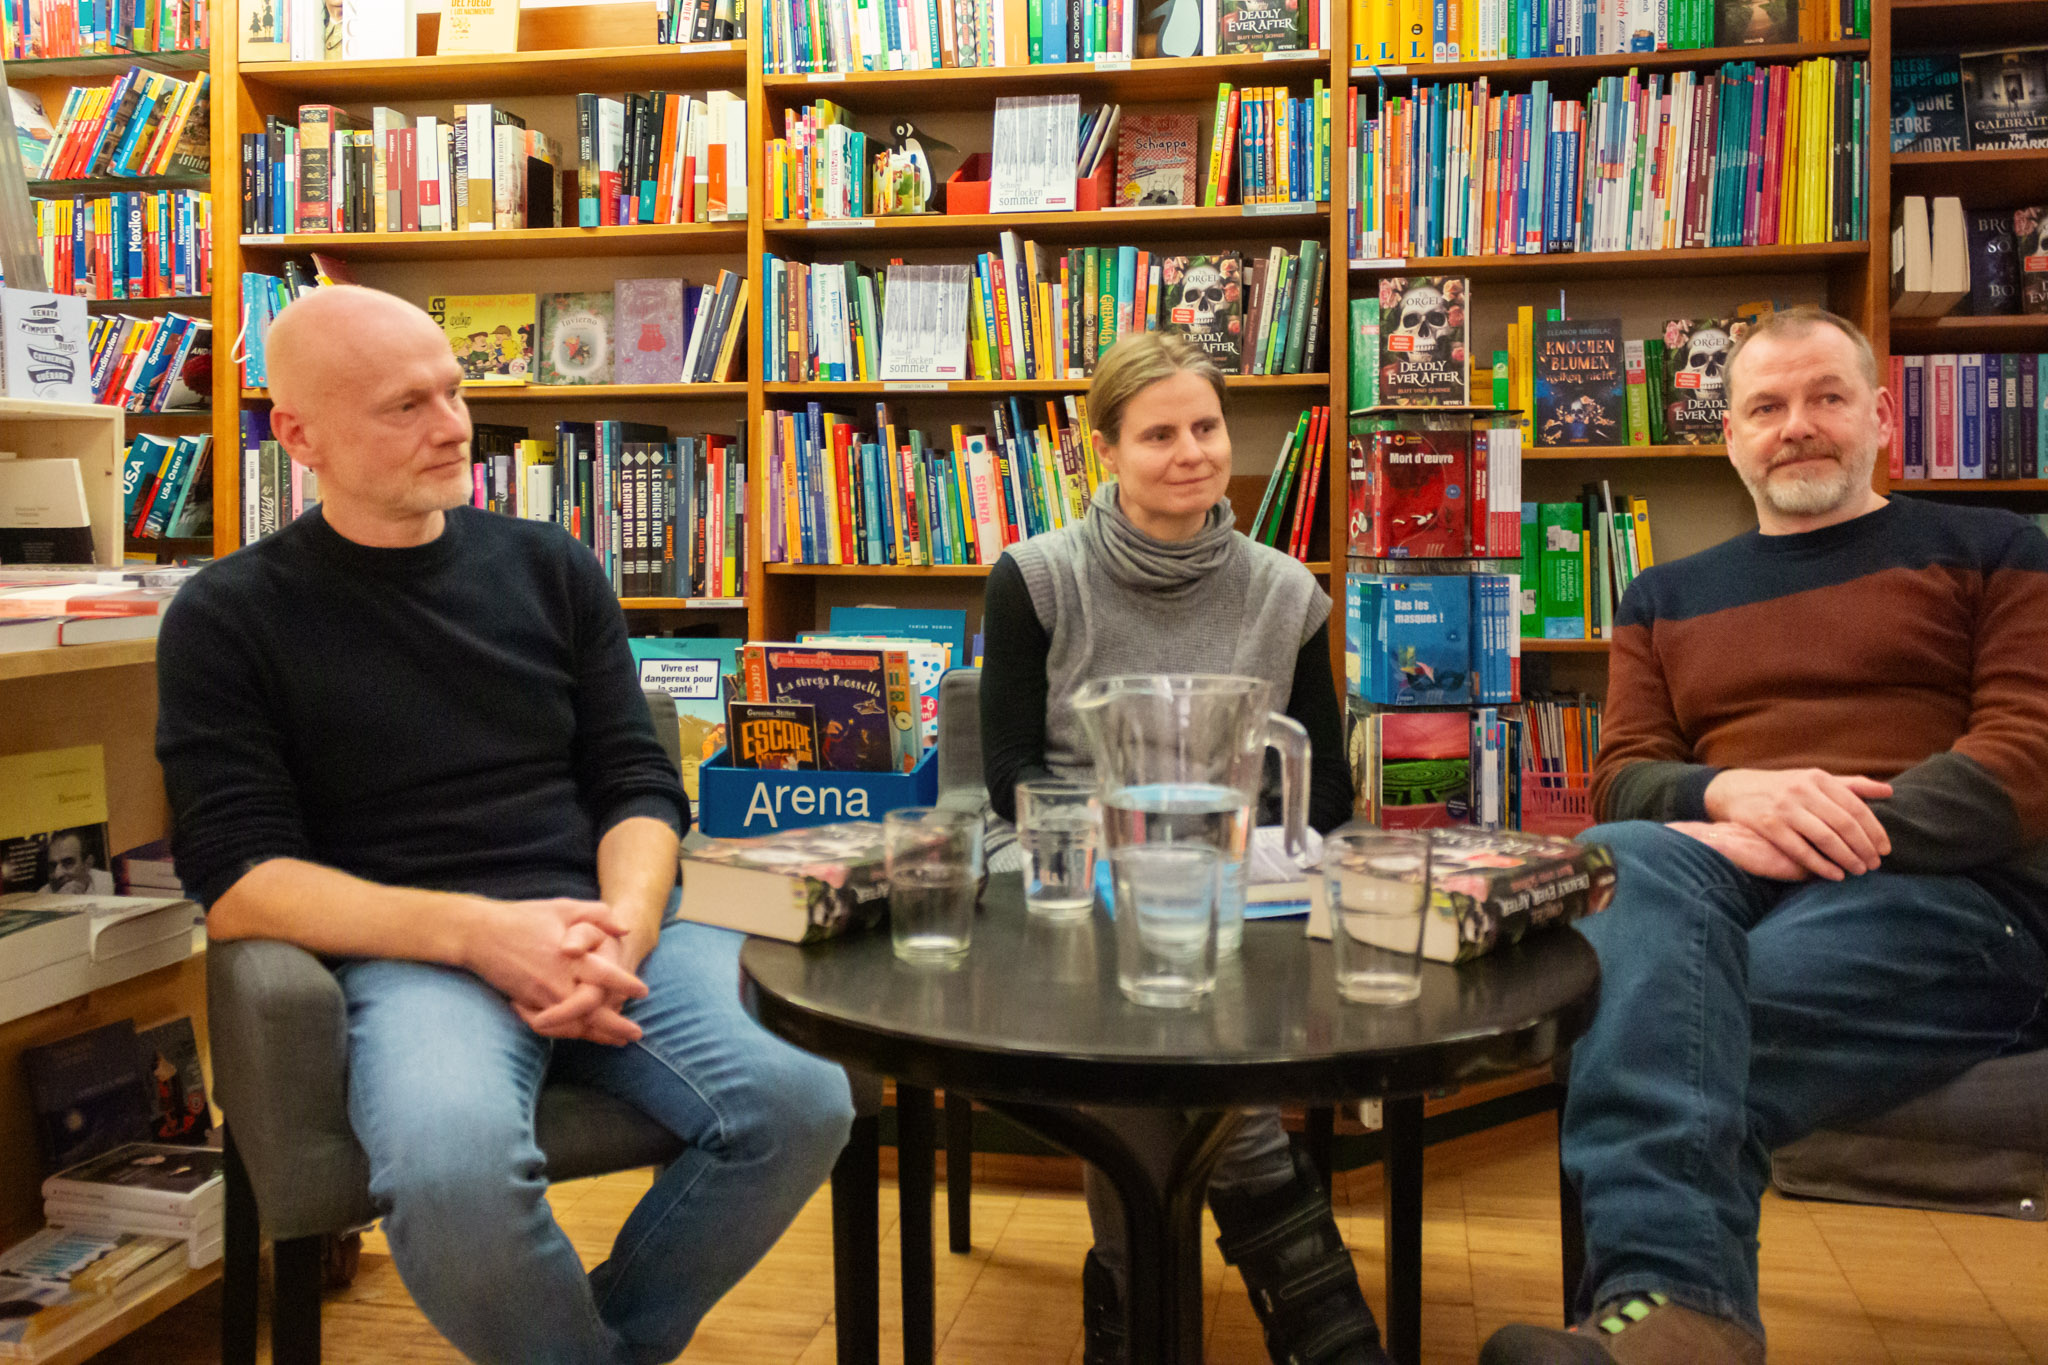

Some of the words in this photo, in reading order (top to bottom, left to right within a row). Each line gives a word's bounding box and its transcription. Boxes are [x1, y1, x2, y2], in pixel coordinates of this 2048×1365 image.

[1238, 8, 1282, 21] DEADLY
[1436, 4, 1444, 31] French
[1449, 4, 1458, 31] French
[1228, 20, 1264, 33] EVER
[1258, 18, 1298, 32] AFTER
[1135, 135, 1187, 154] Schiappa
[1554, 163, 1562, 172] DU
[1567, 163, 1575, 172] DU
[998, 196, 1039, 206] sommer
[75, 213, 83, 242] Marokko
[1552, 203, 1560, 238] GRAMMAIRE
[128, 210, 142, 253] Mexiko
[1187, 274, 1217, 284] ORGEL
[1406, 297, 1440, 308] ORGEL
[32, 309, 59, 318] RENATA
[561, 316, 599, 328] Invierno
[1183, 332, 1224, 343] DEADLY
[1693, 338, 1726, 348] ORGEL
[148, 330, 168, 366] Spanien
[1202, 341, 1241, 355] AFTER
[1546, 339, 1615, 356] KNOCHEN
[90, 332, 120, 389] Skandinavien
[1399, 360, 1447, 373] DEADLY
[1551, 355, 1609, 371] BLUMEN
[889, 364, 929, 373] sommer
[1387, 373, 1428, 387] EVER
[1420, 371, 1465, 386] AFTER
[1675, 409, 1713, 423] EVER
[1389, 453, 1413, 464] Mort
[1414, 453, 1454, 464] d'œuvre
[159, 483, 172, 500] USA
[167, 455, 183, 481] Osten
[622, 470, 633, 481] LE
[636, 469, 648, 480] LE
[651, 469, 662, 479] LE
[622, 482, 633, 519] DERNIER
[636, 482, 648, 519] DERNIER
[651, 481, 662, 519] DERNIER
[974, 474, 991, 525] SCIENZA
[622, 522, 633, 548] ATLAS
[636, 521, 648, 548] ATLAS
[651, 521, 662, 548] ATLAS
[1394, 599, 1412, 611] Bas
[1414, 599, 1430, 611] les
[1394, 613, 1438, 625] masques
[660, 663, 681, 674] Vivre
[683, 664, 699, 674] est
[644, 674, 691, 685] dangereux
[693, 675, 714, 686] pour
[776, 682, 792, 695] La
[795, 676, 829, 690] strega
[668, 684, 692, 694] santé
[741, 718, 813, 761] ESCAPE
[743, 781, 871, 828] Arena
